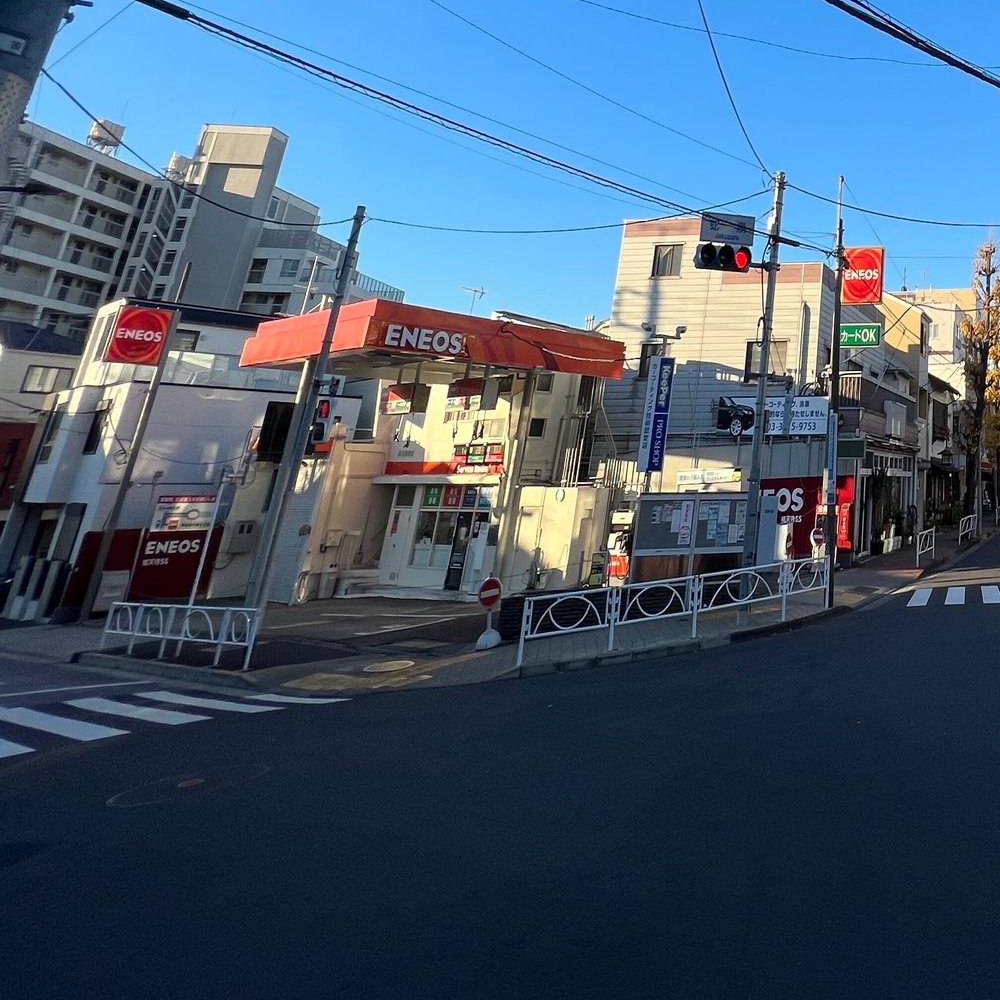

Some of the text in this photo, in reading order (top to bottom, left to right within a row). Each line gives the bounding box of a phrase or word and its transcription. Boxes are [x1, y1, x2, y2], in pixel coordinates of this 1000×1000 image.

[844, 269, 879, 280] ENEOS
[115, 328, 163, 343] ENEOS
[384, 324, 463, 354] ENEOS
[840, 328, 877, 343] カードOK
[652, 419, 664, 466] PRO SHOP
[145, 539, 201, 555] ENEOS
